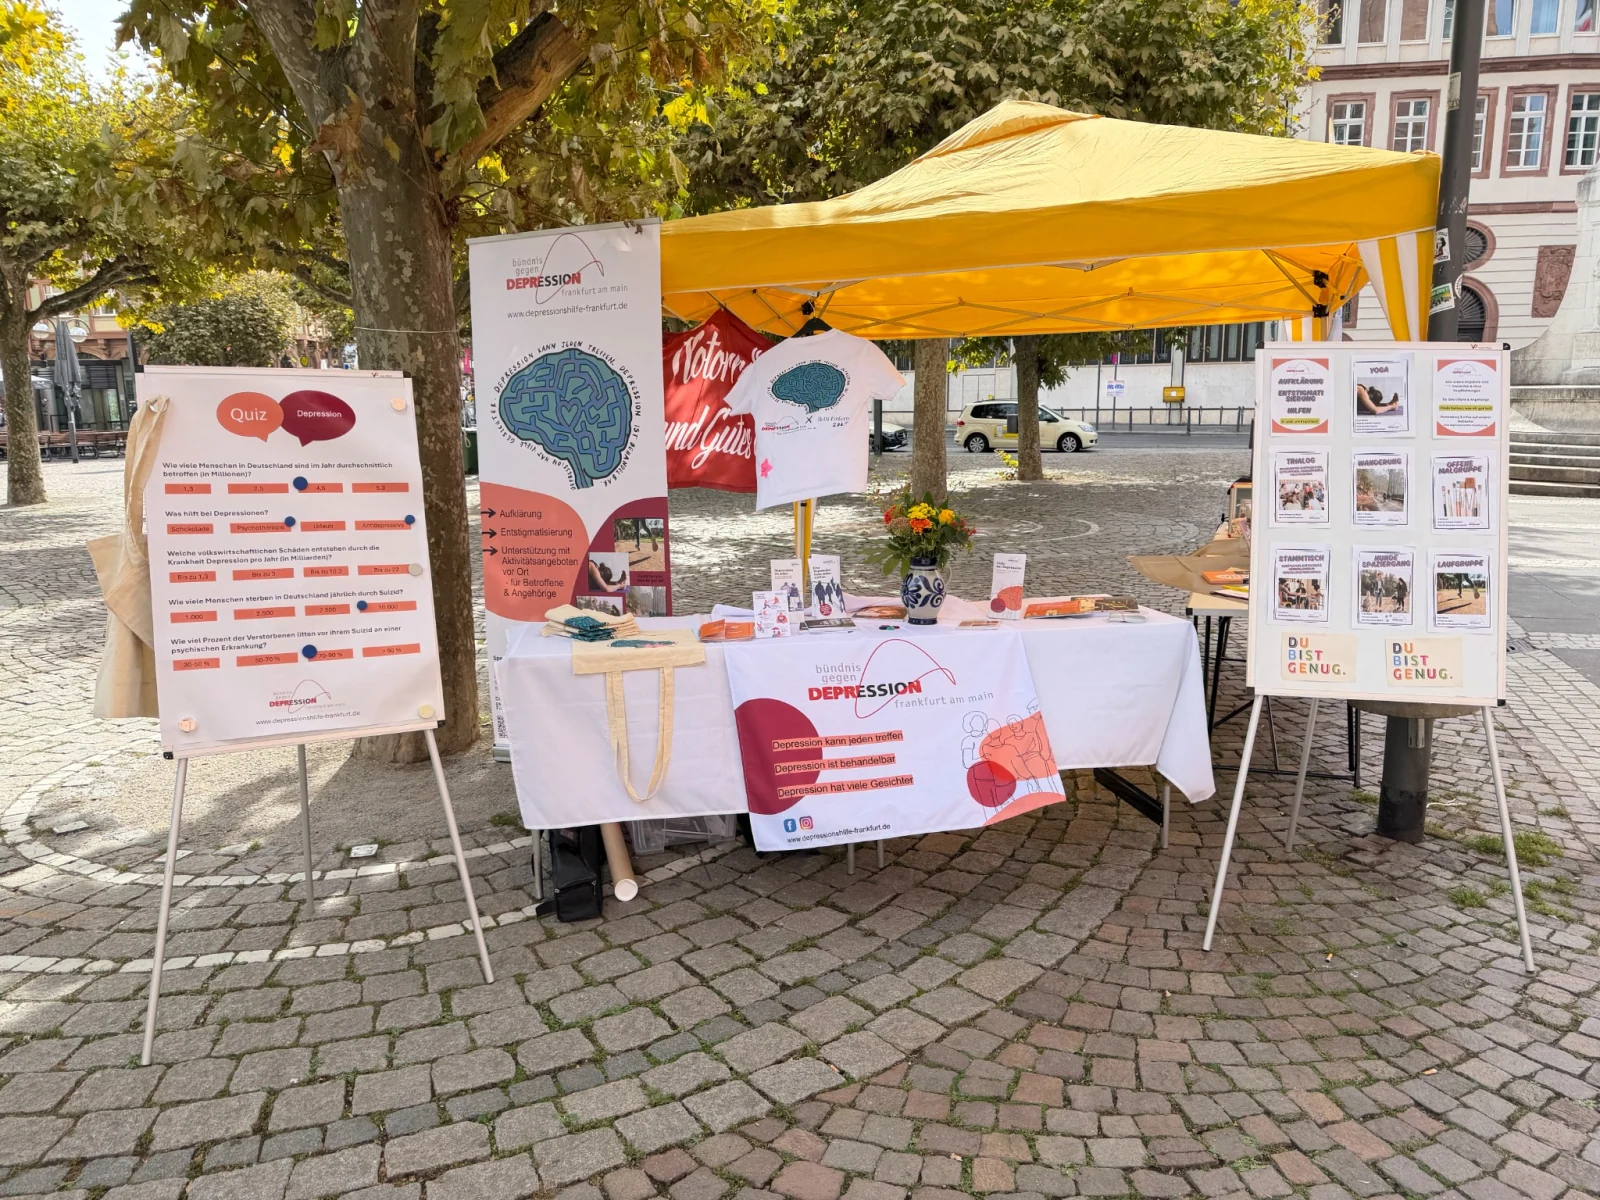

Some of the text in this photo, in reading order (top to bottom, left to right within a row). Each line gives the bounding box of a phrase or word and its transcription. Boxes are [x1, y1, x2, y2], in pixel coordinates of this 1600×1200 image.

[512, 257, 543, 268] bündnis
[515, 266, 539, 277] gegen
[506, 272, 582, 290] DEPRESSION
[561, 288, 597, 297] frankfurt
[610, 285, 628, 293] main
[507, 302, 628, 319] www.depressionshilfe-frankfurt.de
[537, 343, 557, 354] KANN
[493, 353, 535, 393] DEPRESSION
[1369, 366, 1390, 375] YOGA
[1278, 377, 1324, 386] AUFKLÄRUNG
[619, 366, 643, 417] DEPRESSION
[1278, 389, 1324, 397] ENTSTIGMATI
[1285, 395, 1317, 404] SIERUNG
[230, 407, 267, 423] Quiz
[297, 409, 342, 419] Depression
[1287, 406, 1312, 415] HILFEN
[632, 425, 642, 441] IST
[691, 407, 753, 470] Gutes
[537, 452, 550, 463] HAT
[1287, 457, 1316, 467] TRIALOG
[1358, 458, 1402, 467] WANDERUNG
[1447, 460, 1474, 468] OFFENE
[552, 457, 577, 491] DEPRESSION
[1438, 466, 1482, 475] MALGRUPPE
[214, 510, 269, 519] Depressionen?
[499, 510, 542, 520] Aufklärung
[313, 522, 334, 530] Urlaub
[501, 528, 573, 538] Entstigmatisierung
[167, 550, 196, 558] Welche
[198, 549, 278, 557] volkswirtschaftlichen
[501, 546, 570, 557] Unterstützung mit
[168, 558, 205, 566] Krankheit
[206, 557, 249, 566] Depression
[291, 554, 332, 562] Milliarden)?
[501, 557, 579, 567] Aktivitätsangeboten
[1278, 555, 1325, 563] STAMMTISCH
[1374, 554, 1398, 562] HUNDE
[1361, 560, 1411, 569] SPAZIERGANG
[1437, 560, 1486, 569] LAUFGRUPPE
[516, 568, 530, 576] Ort
[511, 578, 521, 586] für
[523, 578, 564, 587] Betroffene
[283, 593, 329, 601] Deutschland
[330, 592, 357, 600] jährlich
[379, 589, 404, 597] Suizid?
[503, 589, 557, 599] & Angehörige
[203, 636, 231, 644] Prozent
[247, 633, 295, 641] Verstorbenen
[1288, 637, 1310, 649] DU
[171, 643, 267, 656] psychischen Erkrankung?
[1392, 643, 1414, 655] DU
[1288, 650, 1323, 662] BIST
[1392, 655, 1429, 668] BIST
[816, 663, 862, 675] bündnis
[1288, 663, 1347, 677] GENUG.
[1392, 668, 1454, 681] GENUG.
[821, 673, 858, 686] gegen
[808, 680, 922, 701] DEPRESSION
[269, 697, 317, 708] DEPRESSION
[894, 690, 994, 709] frankfurt am main
[772, 730, 904, 751] Depression kann jeden treffen
[775, 754, 895, 775] Depression ist behandelbar
[778, 775, 914, 798] Depression hat viele Gesichter
[787, 823, 892, 844] www.depressionshilfe-frankfurt.de
